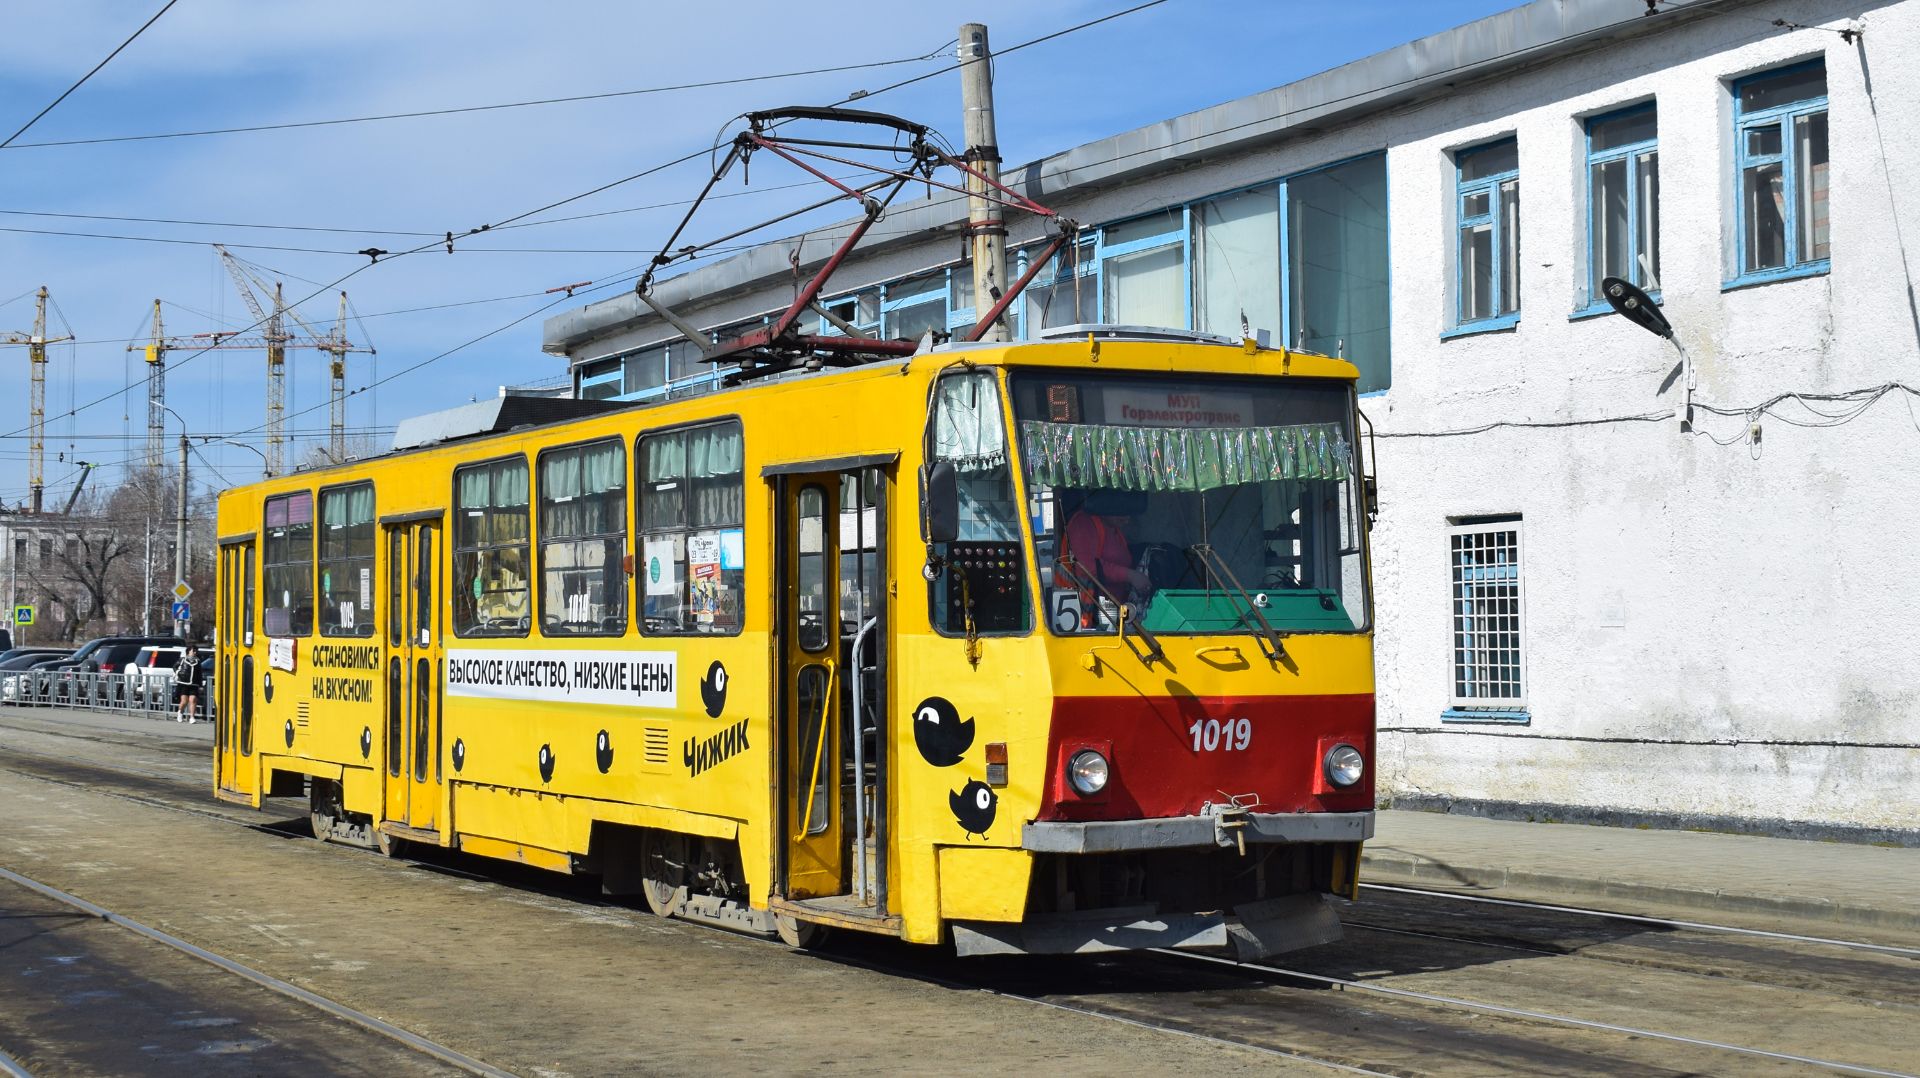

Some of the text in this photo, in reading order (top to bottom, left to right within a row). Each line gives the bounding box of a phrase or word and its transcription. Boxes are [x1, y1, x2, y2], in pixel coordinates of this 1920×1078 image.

[1050, 384, 1069, 421] 5
[1121, 404, 1241, 424] Горэлектротранс
[1167, 393, 1201, 409] МУП
[340, 601, 354, 628] 1019
[568, 593, 588, 623] 1019
[1056, 594, 1080, 632] 5
[312, 645, 379, 670] ОСТАНОВИМСЯ
[312, 677, 373, 703] НА ВКУСНОМ!
[449, 659, 673, 696] ВЫСОКОЕ КАЧЕСТВО, НИЗКИЕ ЦЕНЫ
[1189, 718, 1251, 751] 1019
